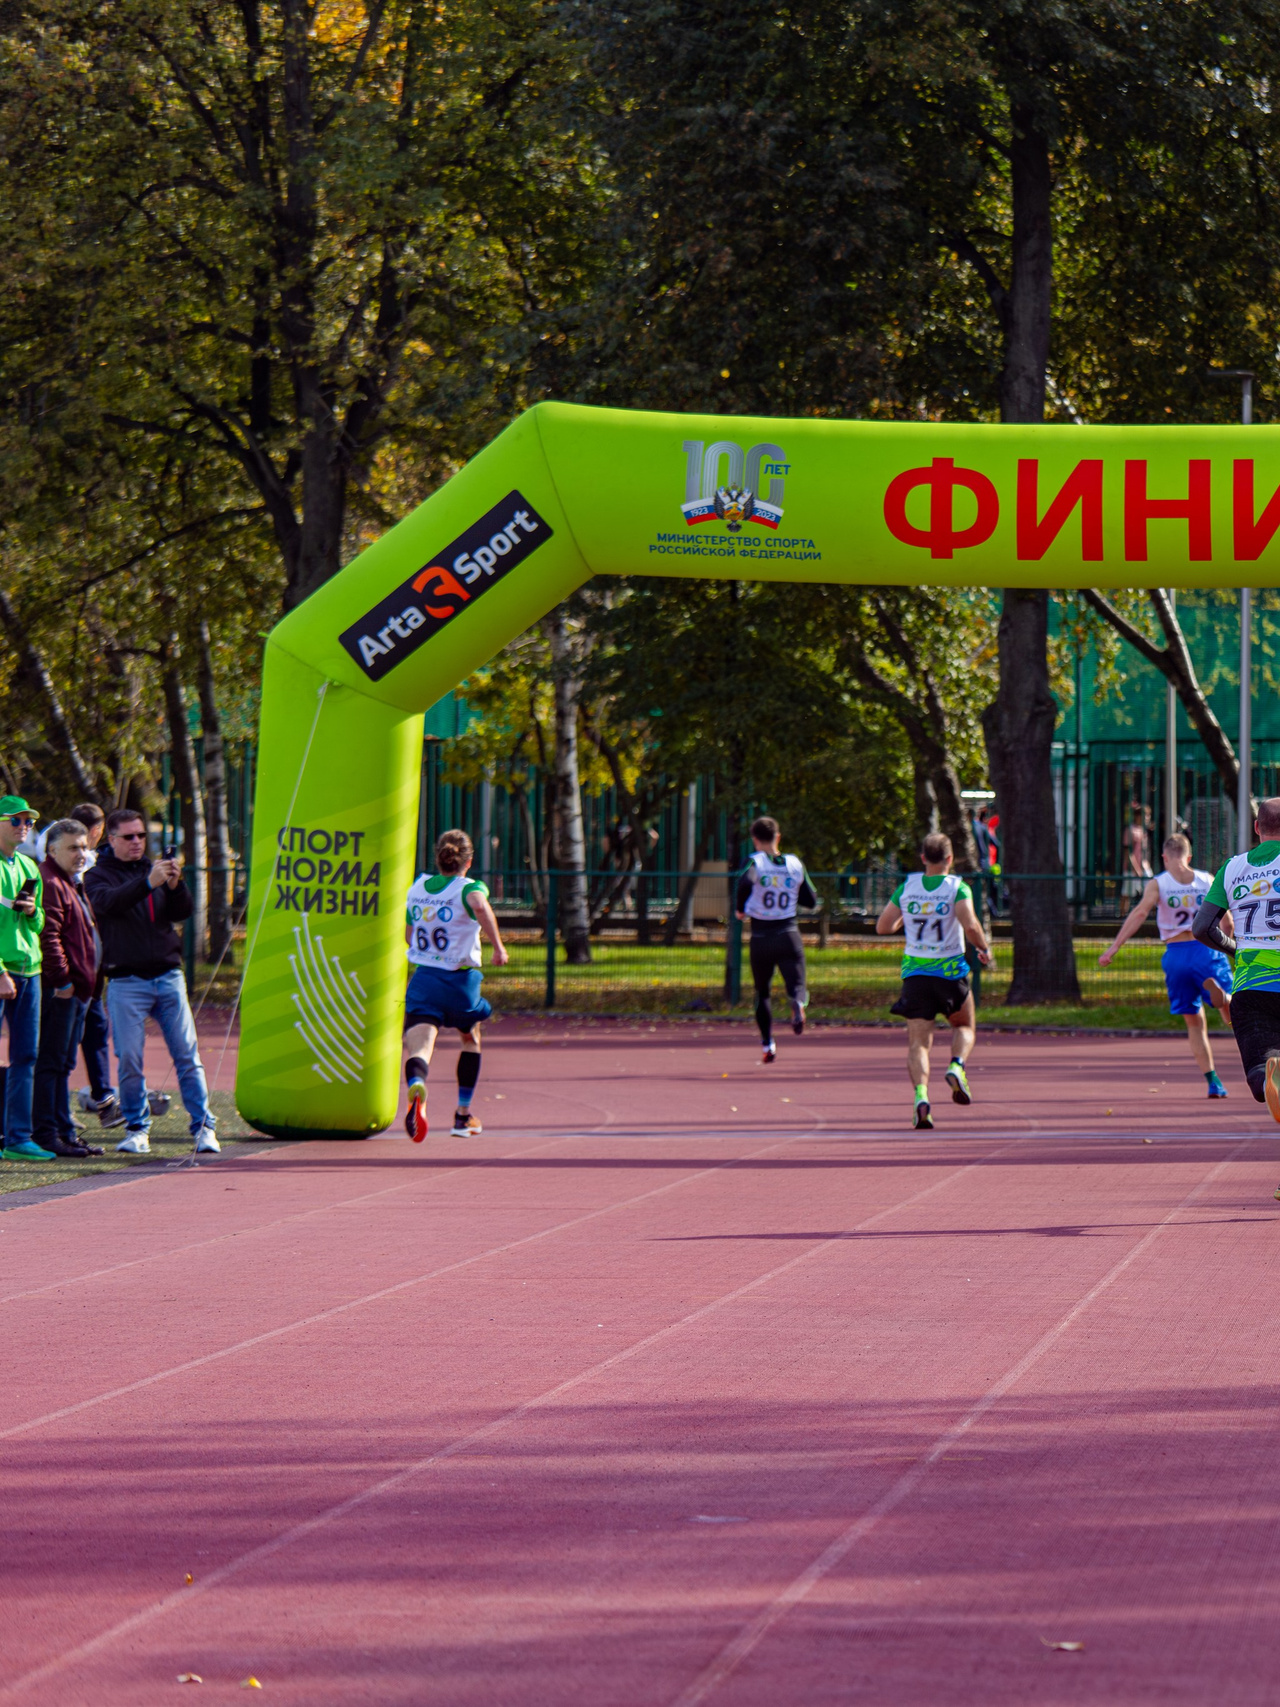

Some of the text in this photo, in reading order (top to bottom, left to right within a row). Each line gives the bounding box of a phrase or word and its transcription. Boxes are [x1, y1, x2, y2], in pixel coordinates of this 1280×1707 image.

[763, 463, 791, 475] ЛЕТ
[690, 506, 709, 518] 1923
[755, 508, 777, 522] 2023
[657, 532, 816, 549] МИНИСТЕРСТВО СПОРТА
[649, 544, 822, 561] РОССИЙСКОЙ ФЕДЕРАЦИИ
[357, 509, 539, 668] Arta Sport
[277, 825, 366, 858] СПОРТ
[276, 854, 382, 887] НОРМА
[274, 883, 380, 917] ЖИЗНИ
[763, 890, 790, 910] 60
[1175, 910, 1199, 927] 2
[416, 926, 448, 952] 66
[911, 918, 944, 941] 71
